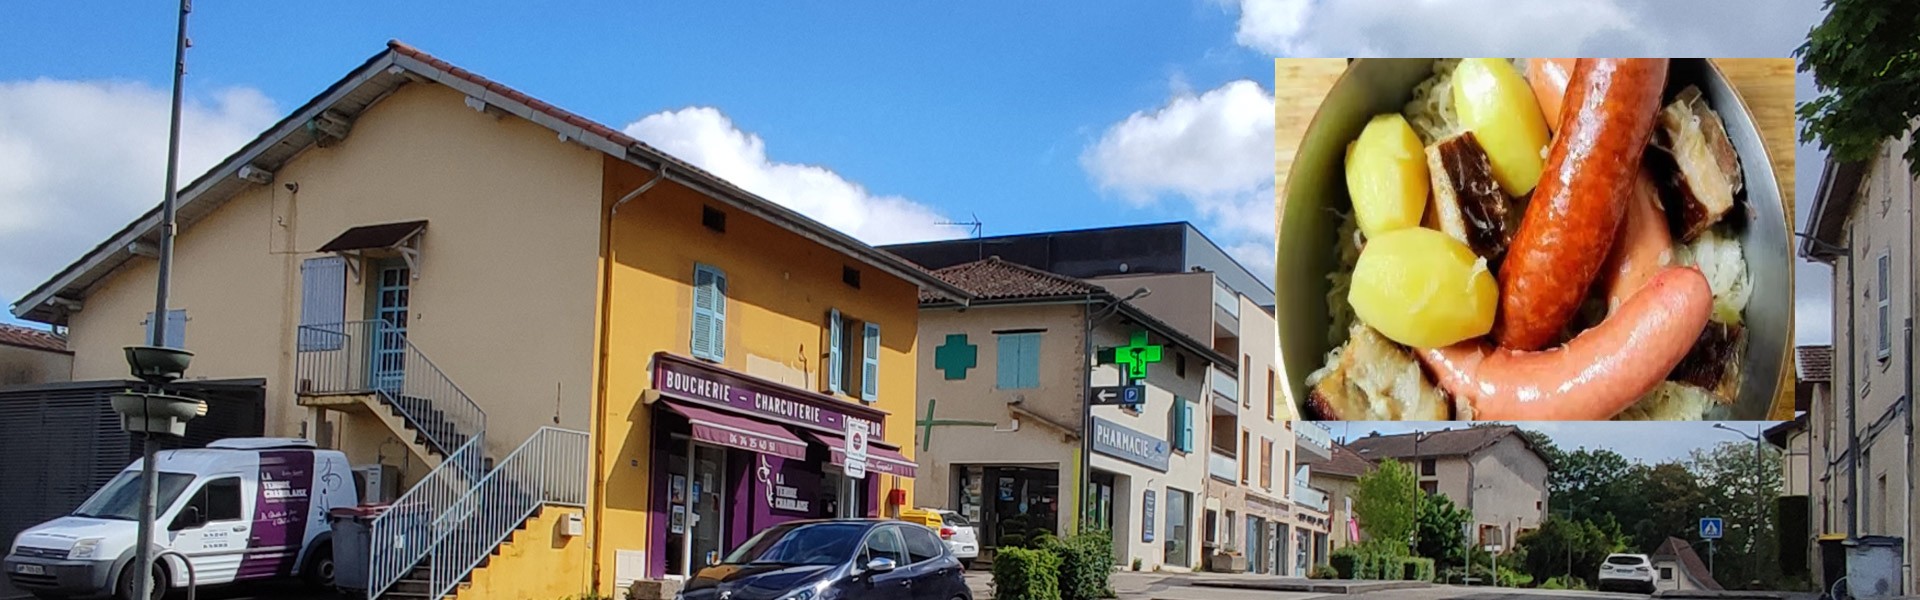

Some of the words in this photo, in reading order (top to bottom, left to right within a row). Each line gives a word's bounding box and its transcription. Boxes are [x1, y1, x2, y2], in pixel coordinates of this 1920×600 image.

[666, 370, 731, 402] BOUCHERIE
[754, 392, 821, 423] CHARCUTERIE
[1097, 424, 1149, 459] PHARMACIE
[261, 471, 272, 480] LA
[776, 473, 785, 485] LA
